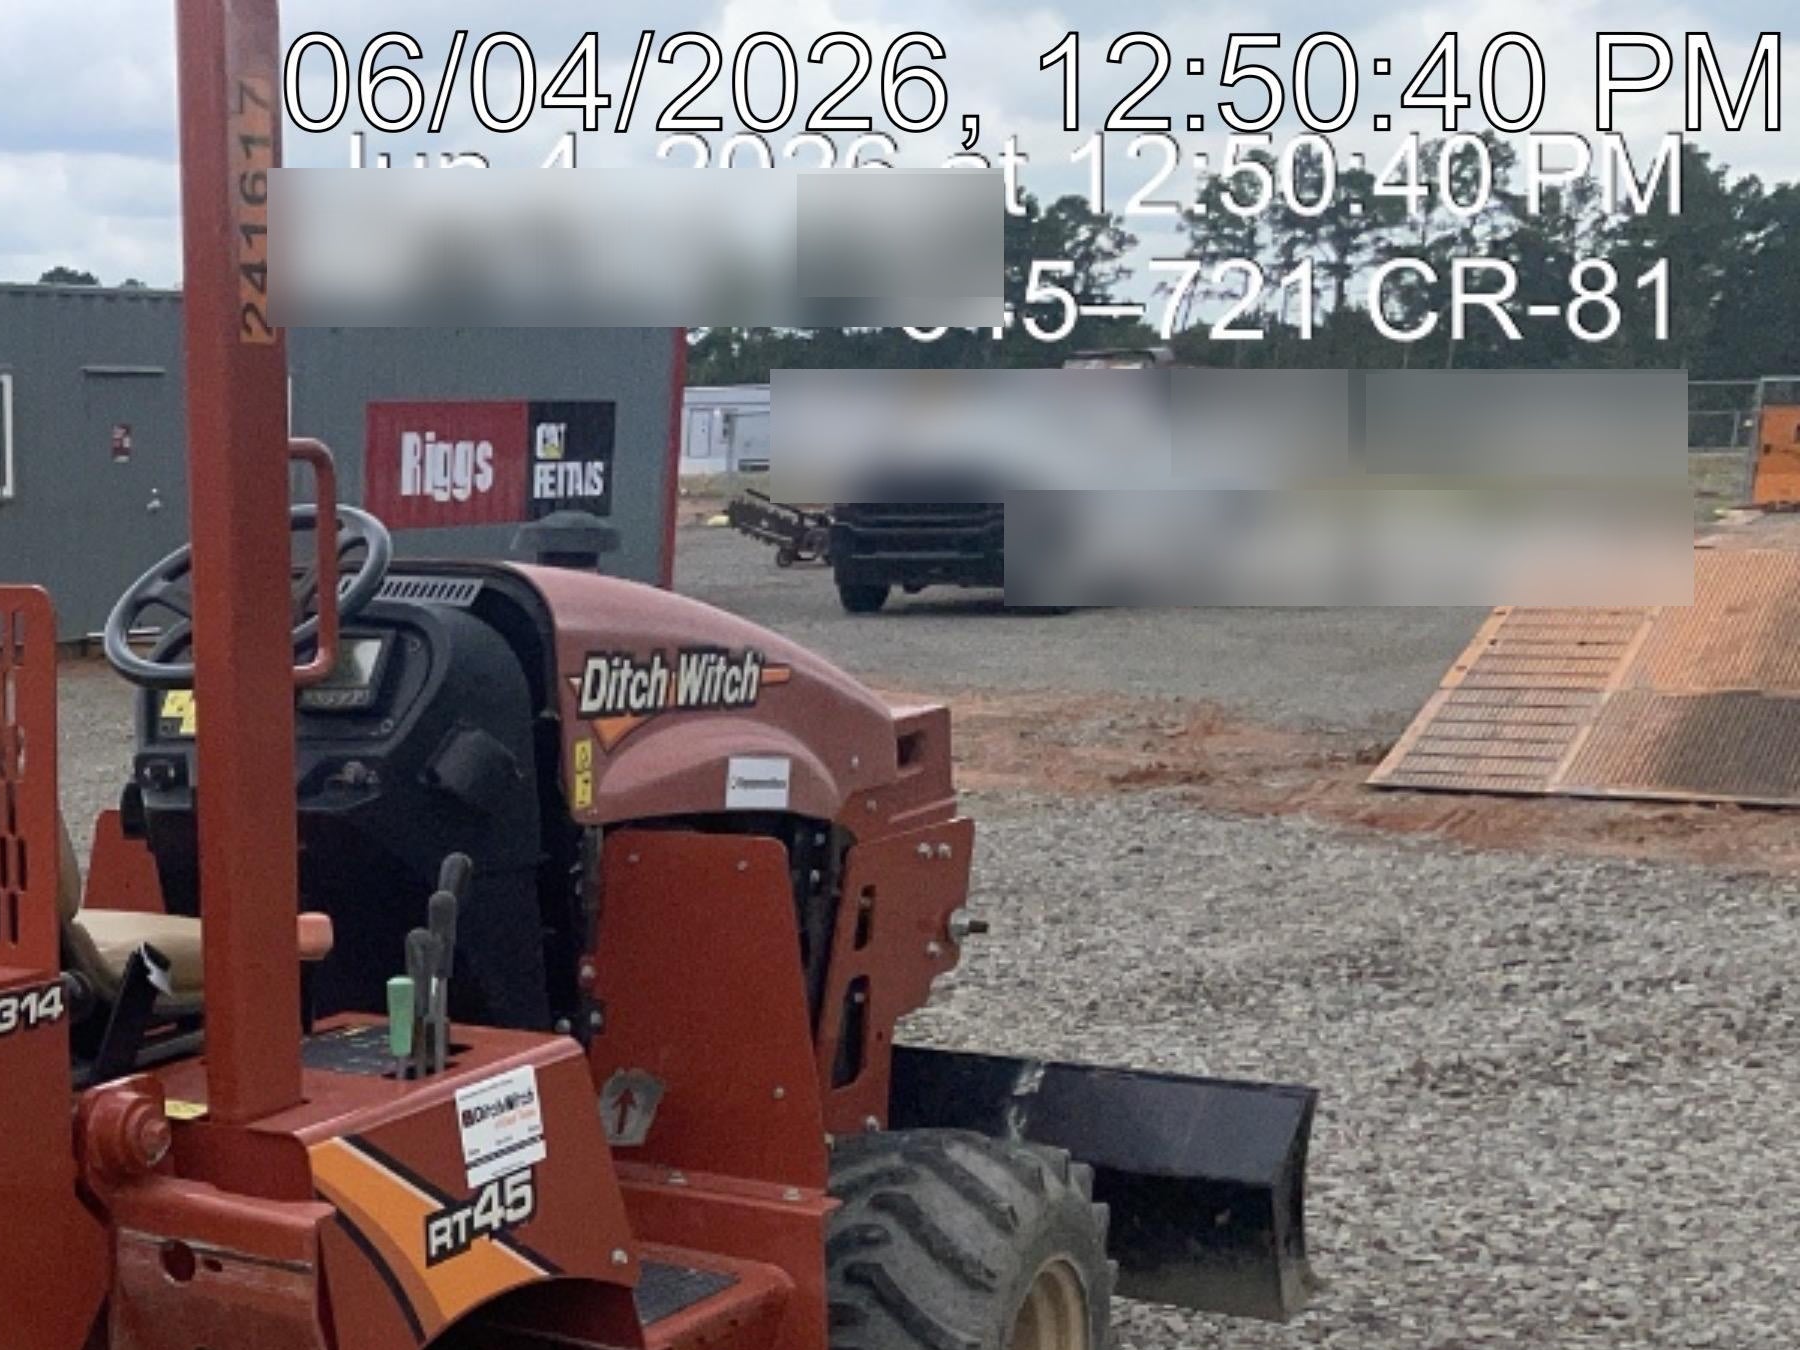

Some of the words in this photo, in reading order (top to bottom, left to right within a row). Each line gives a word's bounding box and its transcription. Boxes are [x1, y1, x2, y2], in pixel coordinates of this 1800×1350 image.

[233, 79, 275, 337] 241617
[401, 431, 494, 501] Riggs
[580, 655, 669, 713] Ditch
[677, 651, 762, 706] Witch
[428, 1168, 533, 1257] RT45
